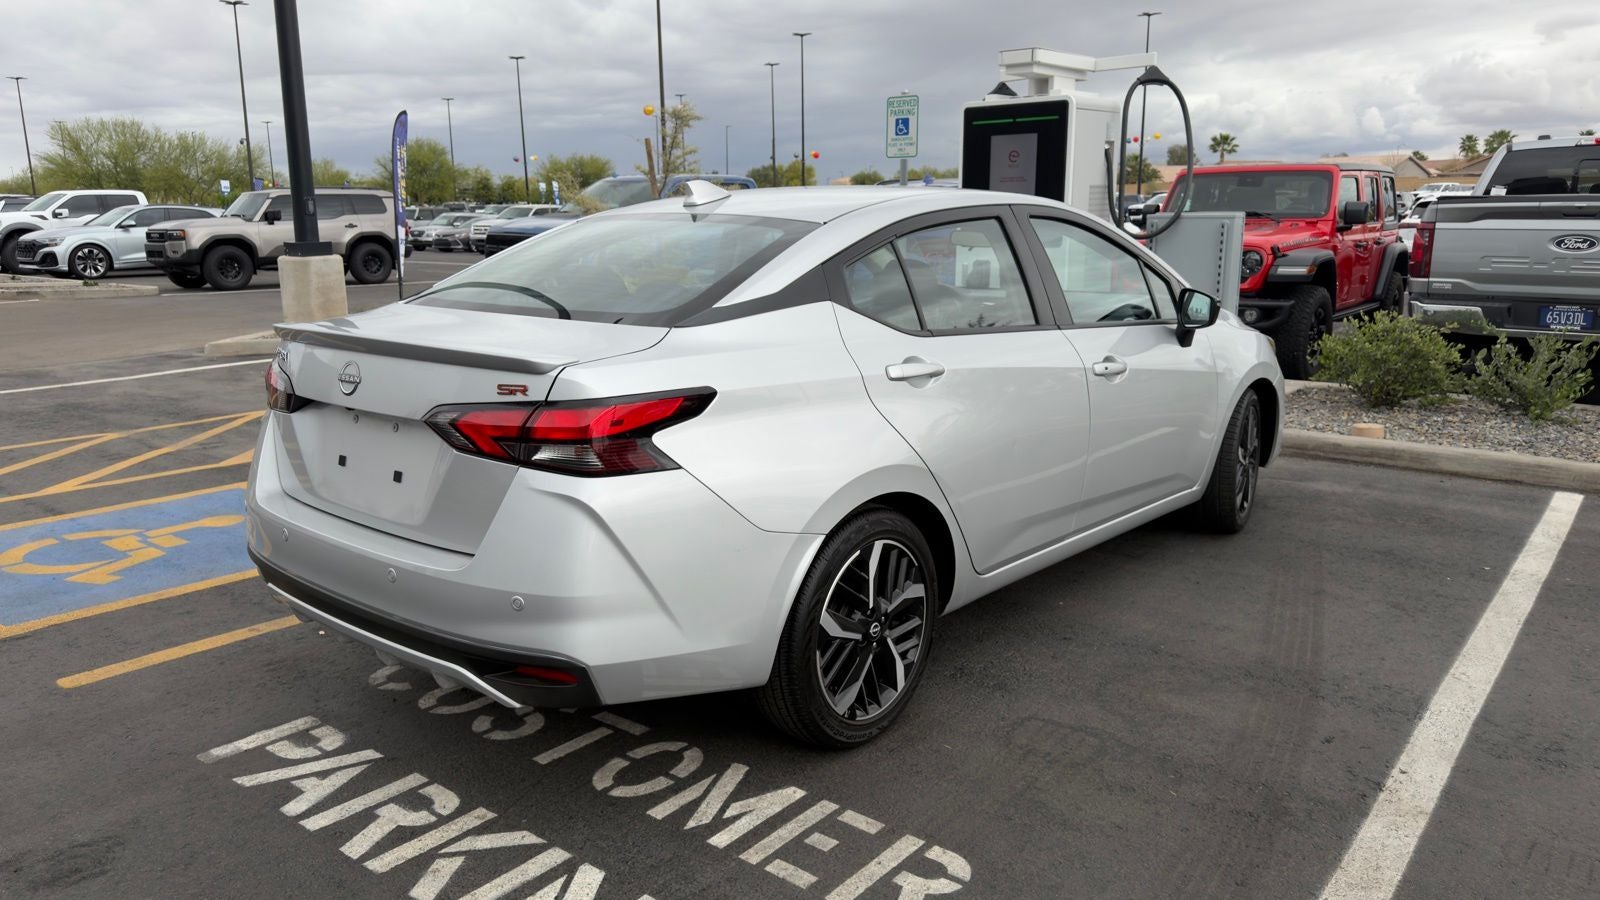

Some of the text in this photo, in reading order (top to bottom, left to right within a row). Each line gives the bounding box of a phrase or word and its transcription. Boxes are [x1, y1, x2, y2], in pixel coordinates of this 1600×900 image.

[888, 98, 918, 109] RESERVED
[889, 108, 916, 118] PARKING
[1560, 238, 1591, 249] Ford
[1546, 311, 1587, 326] 65V3DL
[496, 383, 529, 397] SR
